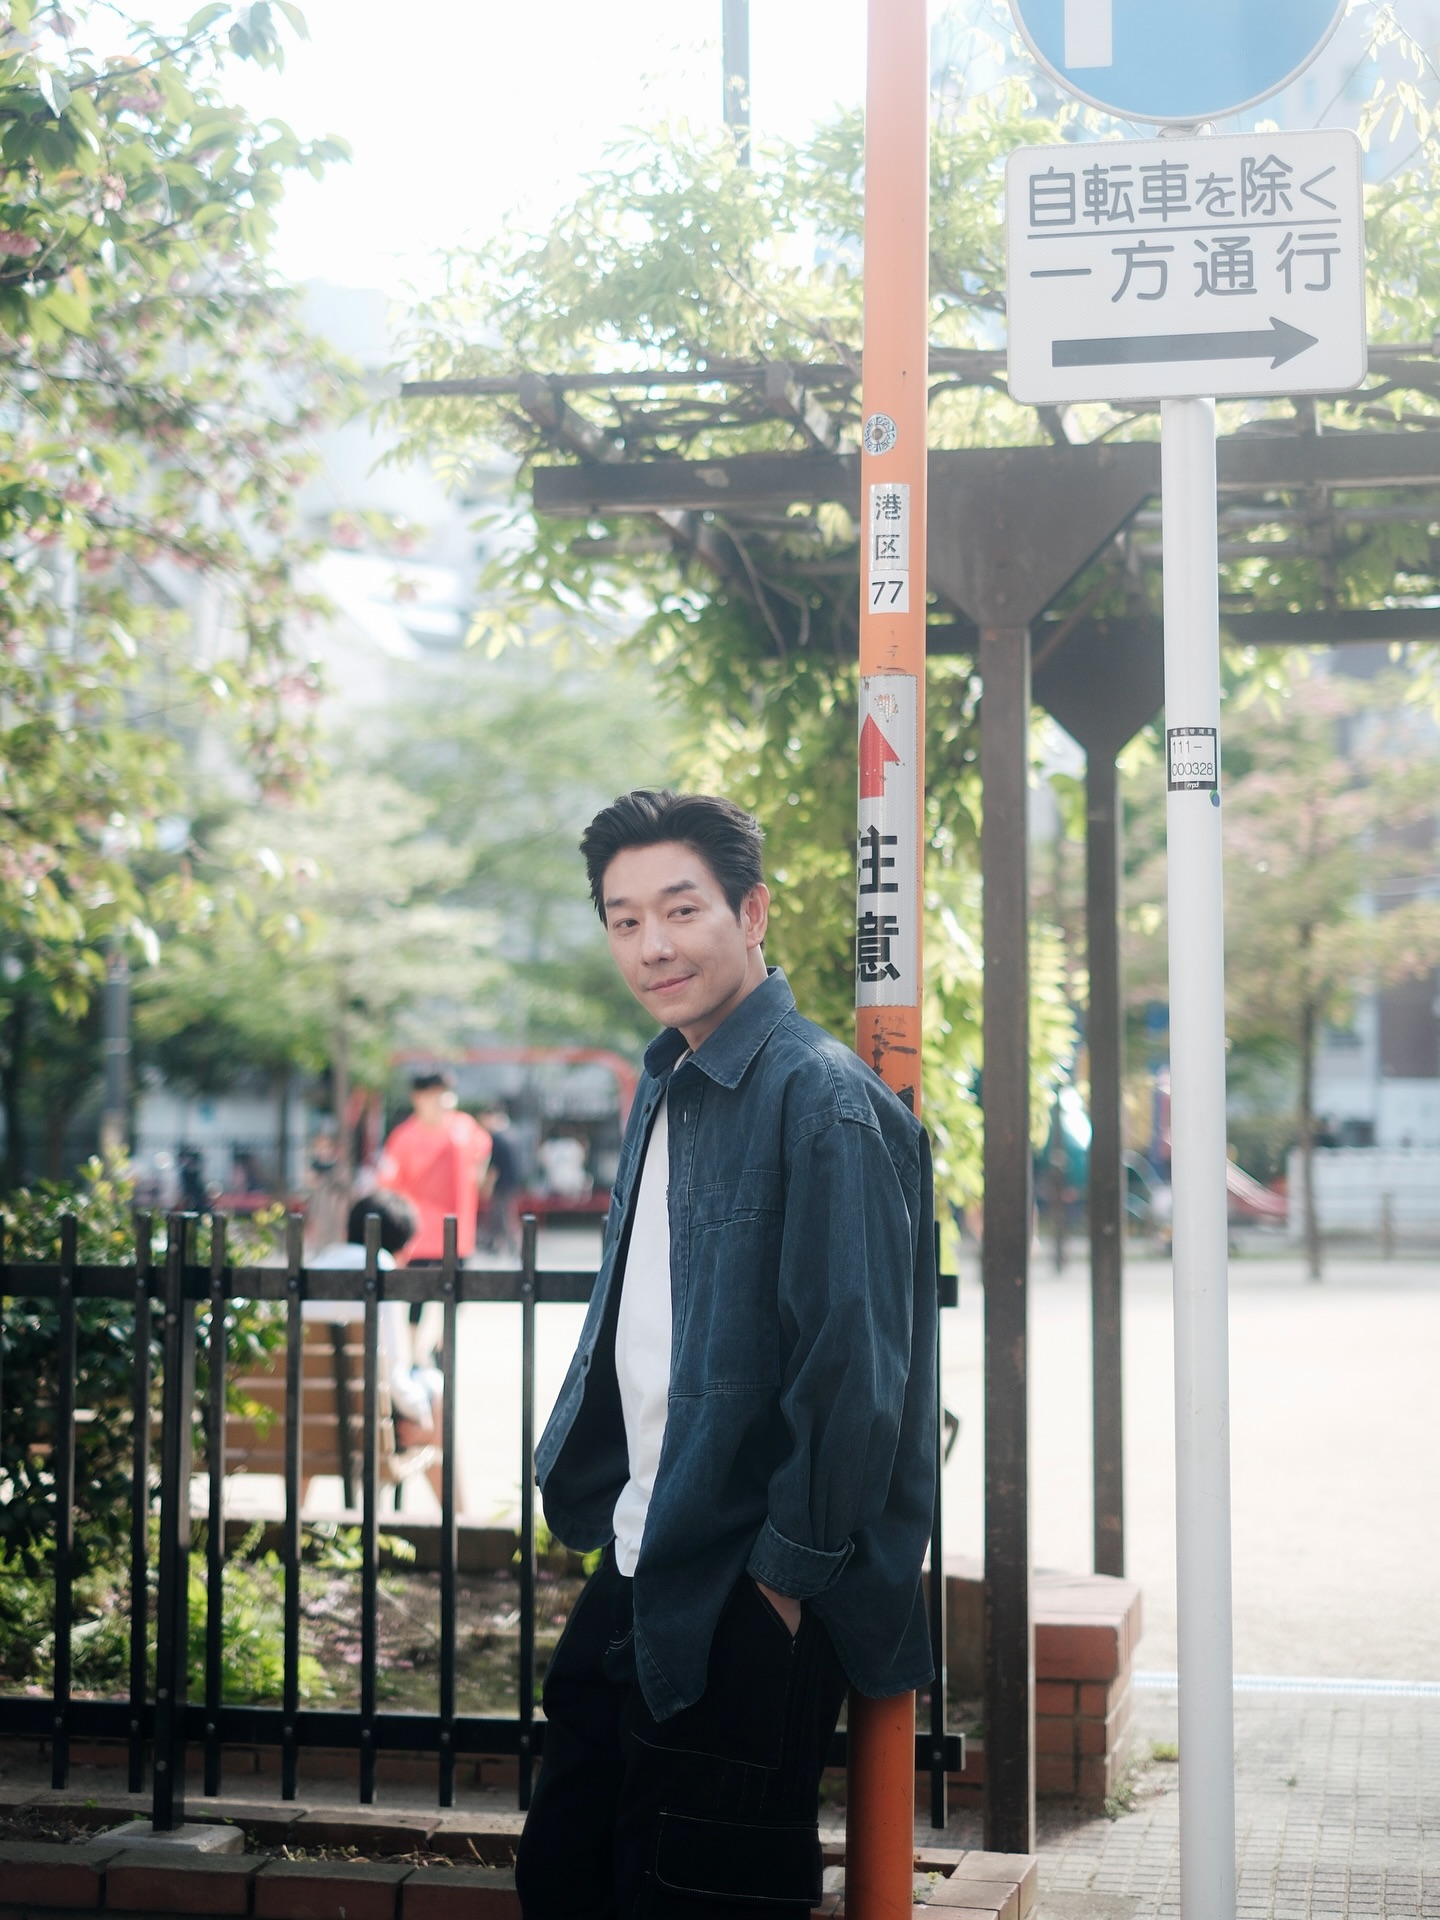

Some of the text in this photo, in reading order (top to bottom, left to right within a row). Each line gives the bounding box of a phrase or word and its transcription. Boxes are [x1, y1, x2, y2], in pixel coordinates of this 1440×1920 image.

[1028, 153, 1338, 228] 自転車を除く
[1029, 231, 1342, 304] 一方通行
[875, 493, 902, 560] 港区
[871, 580, 904, 605] 77
[1171, 762, 1214, 777] 000328
[857, 824, 901, 983] 注意
